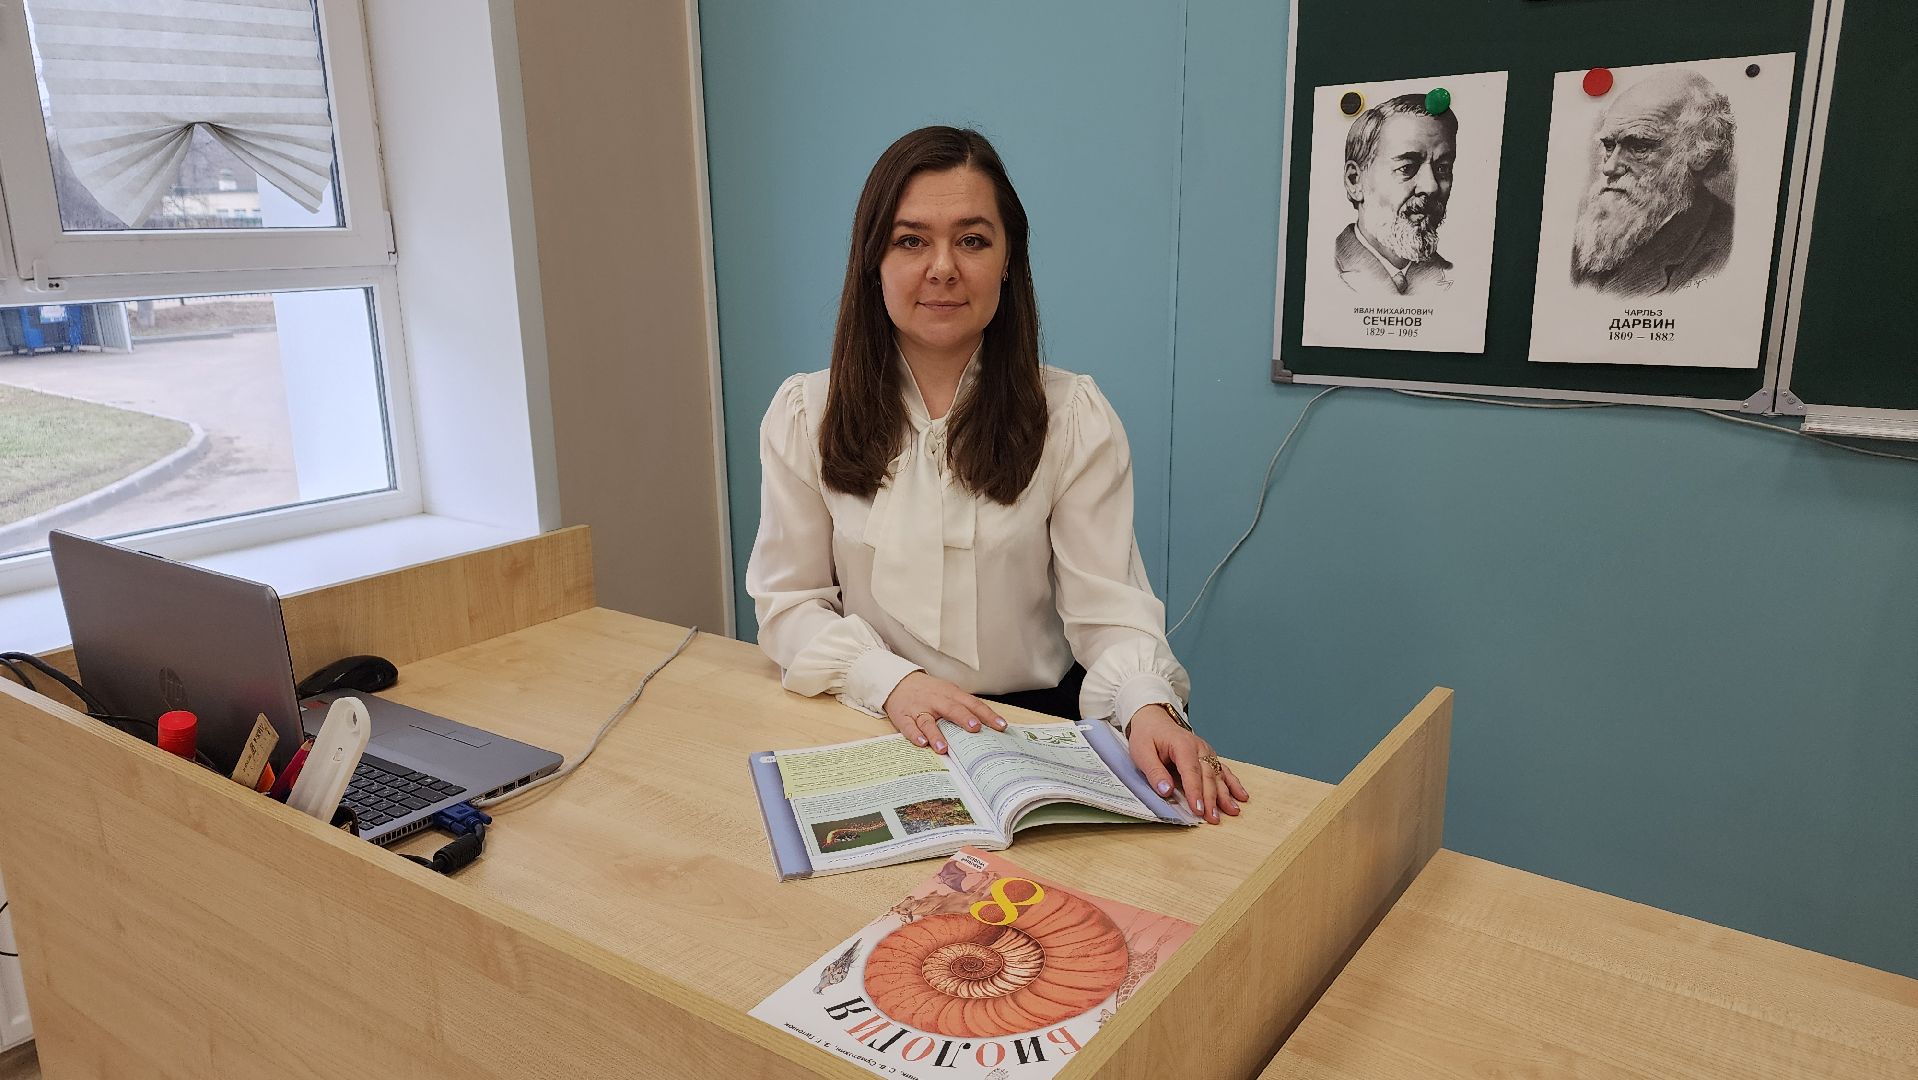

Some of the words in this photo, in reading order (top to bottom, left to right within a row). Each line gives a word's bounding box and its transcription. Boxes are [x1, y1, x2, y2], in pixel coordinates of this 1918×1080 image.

[1376, 307, 1434, 316] МИХАЙЛОВИЧ
[1624, 309, 1663, 317] ЧАРЛЬЗ
[1363, 315, 1422, 327] СЕЧЕНОВ
[1608, 318, 1675, 330] ДАРВИН
[1365, 327, 1385, 336] 1829
[1398, 328, 1419, 337] 1905
[1608, 331, 1633, 341] 1809
[1650, 332, 1675, 341] 1882
[970, 877, 1045, 926] 8
[824, 996, 1083, 1068] БИОЛОГИЯ
